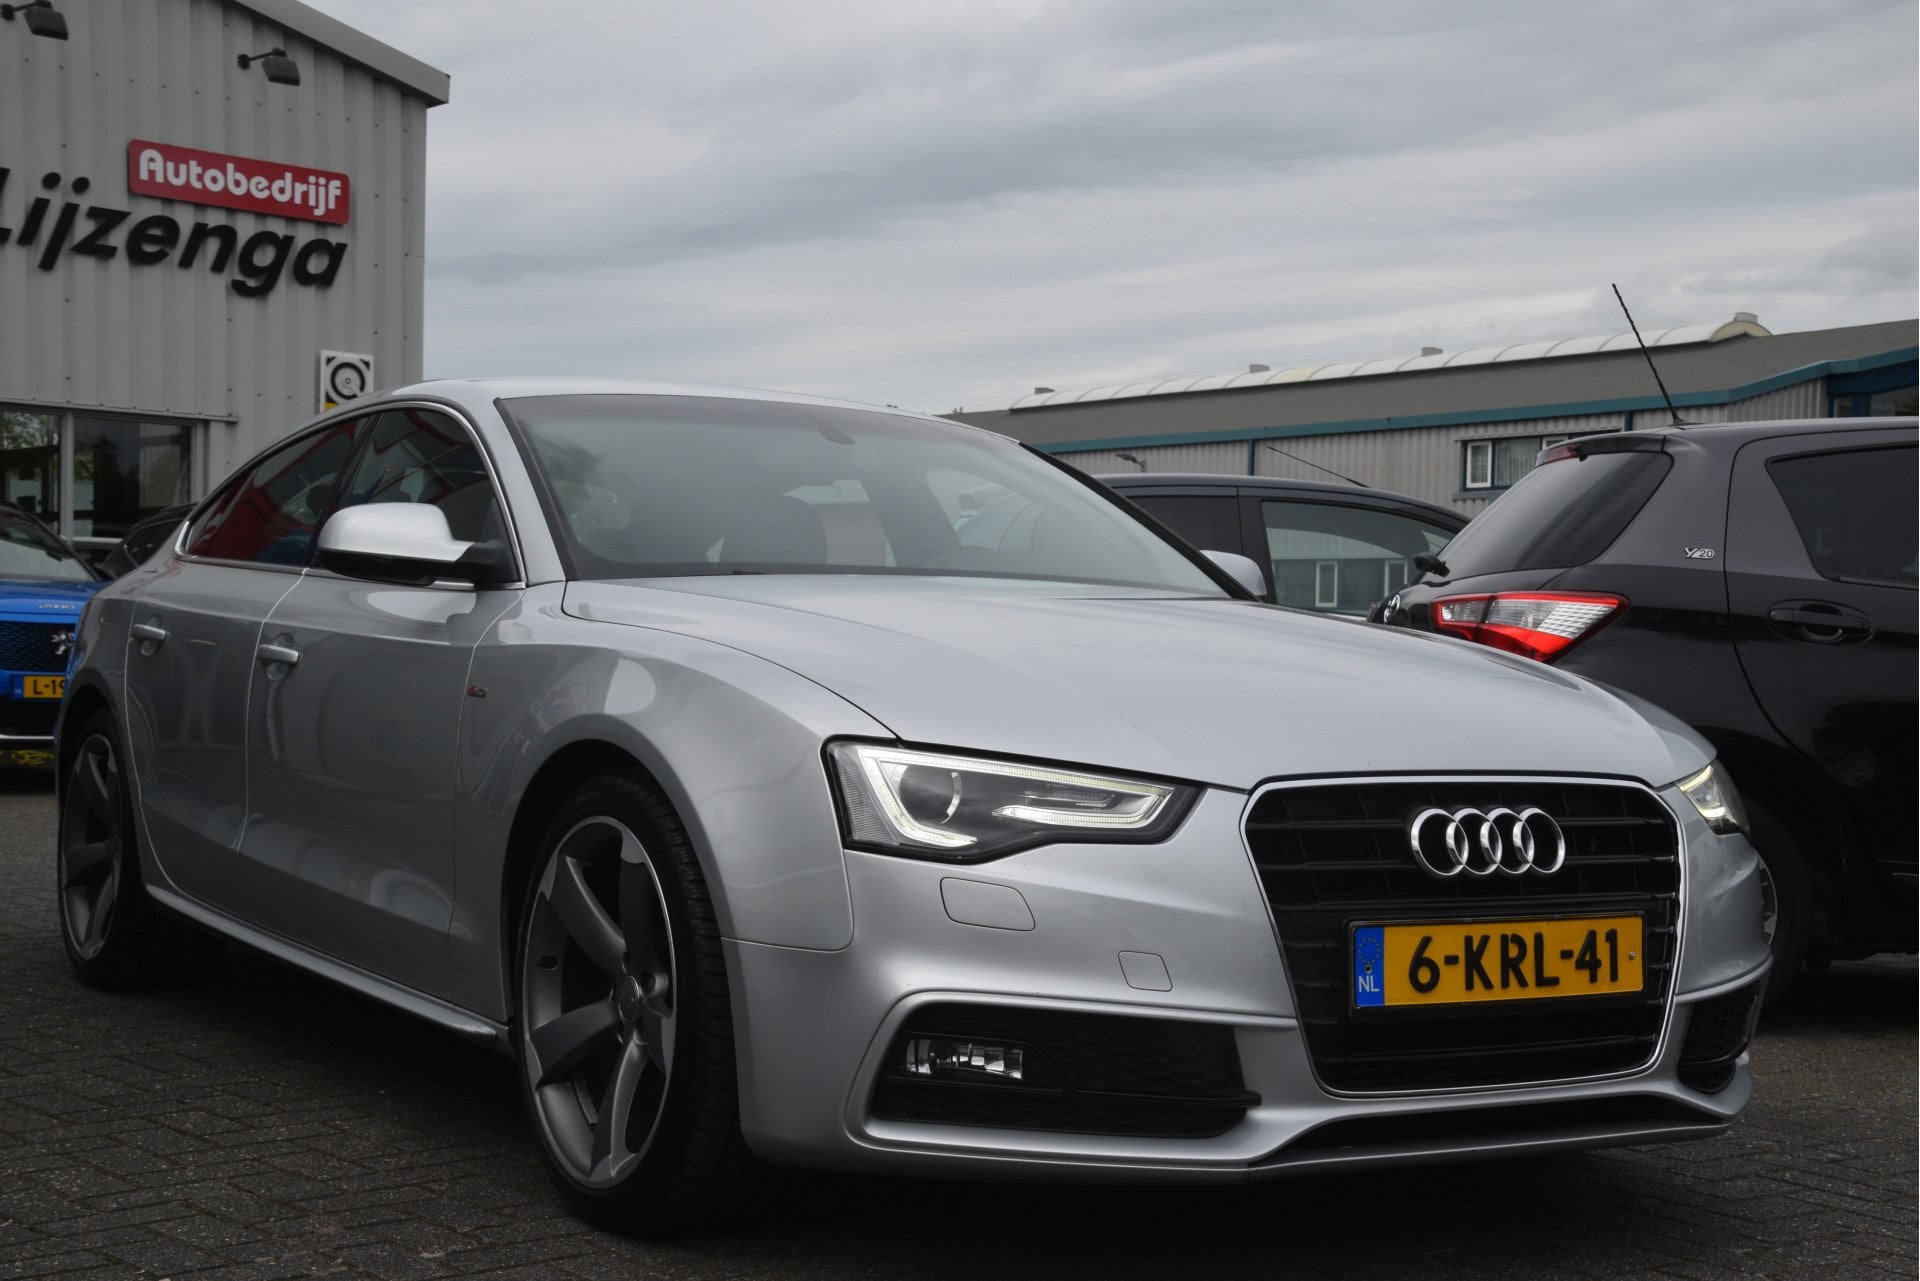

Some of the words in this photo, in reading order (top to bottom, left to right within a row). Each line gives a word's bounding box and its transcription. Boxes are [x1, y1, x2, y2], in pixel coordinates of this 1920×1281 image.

[139, 149, 341, 216] Autobedrijf
[1358, 975, 1380, 993] NL
[1409, 928, 1619, 993] 6-KRL-41
